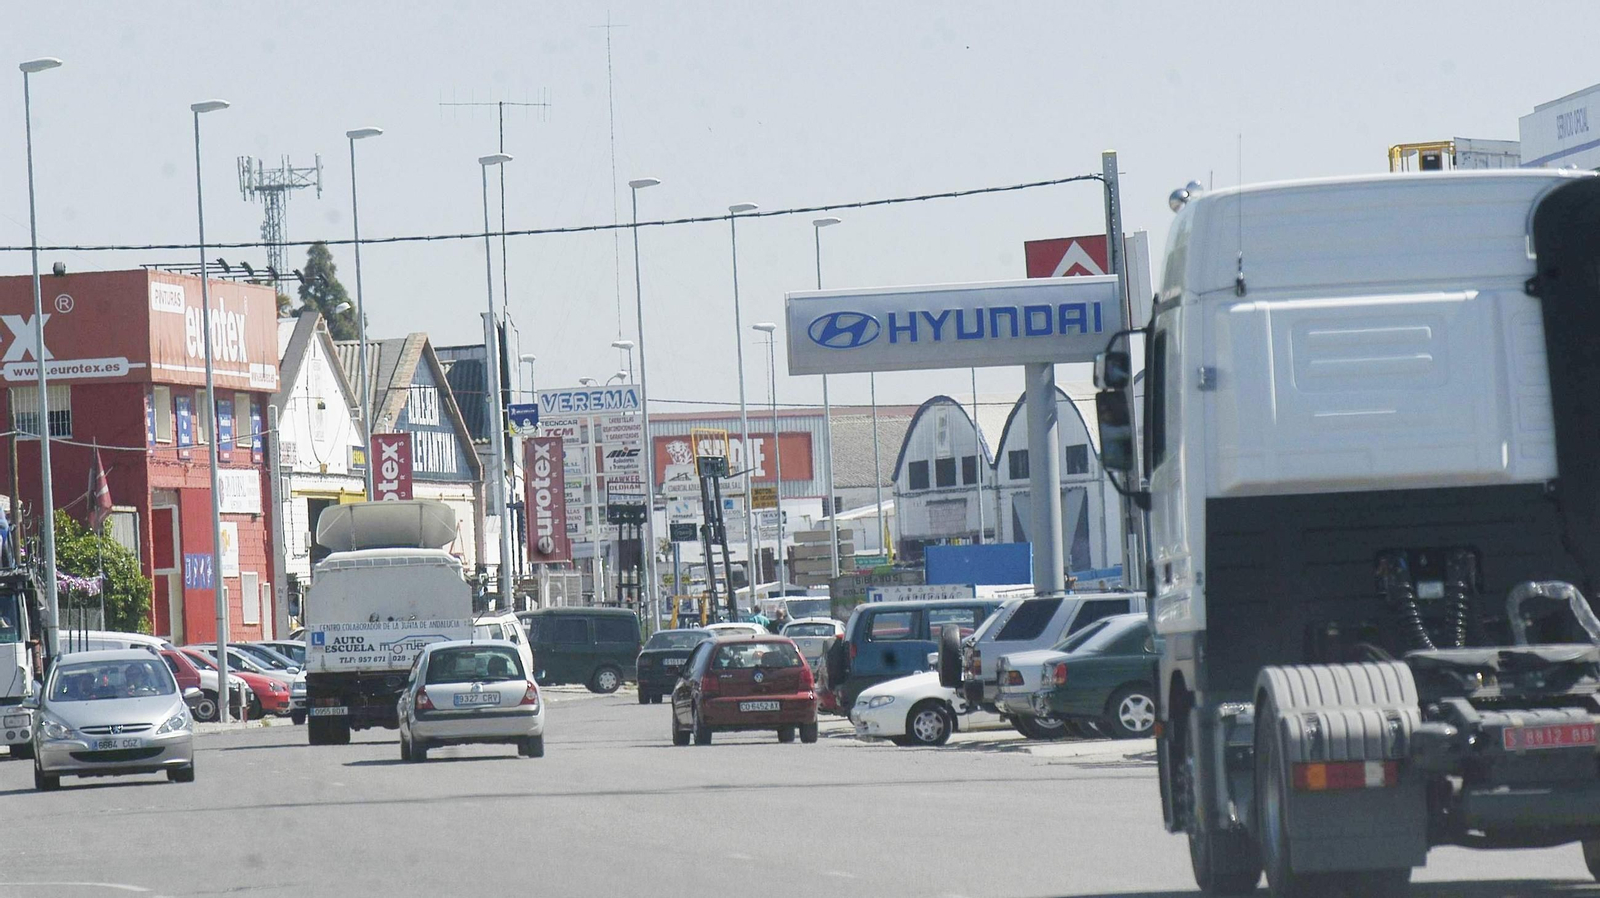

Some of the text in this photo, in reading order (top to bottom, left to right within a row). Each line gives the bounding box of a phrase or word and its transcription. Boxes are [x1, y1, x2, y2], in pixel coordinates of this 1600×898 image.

[888, 301, 1103, 344] HYUNDAI
[540, 389, 639, 413] VEREMA
[545, 428, 574, 437] TCM
[533, 444, 553, 553] eurotex
[333, 636, 364, 644] AUTO
[325, 644, 375, 653] ESCUELA
[482, 693, 498, 702] CRV
